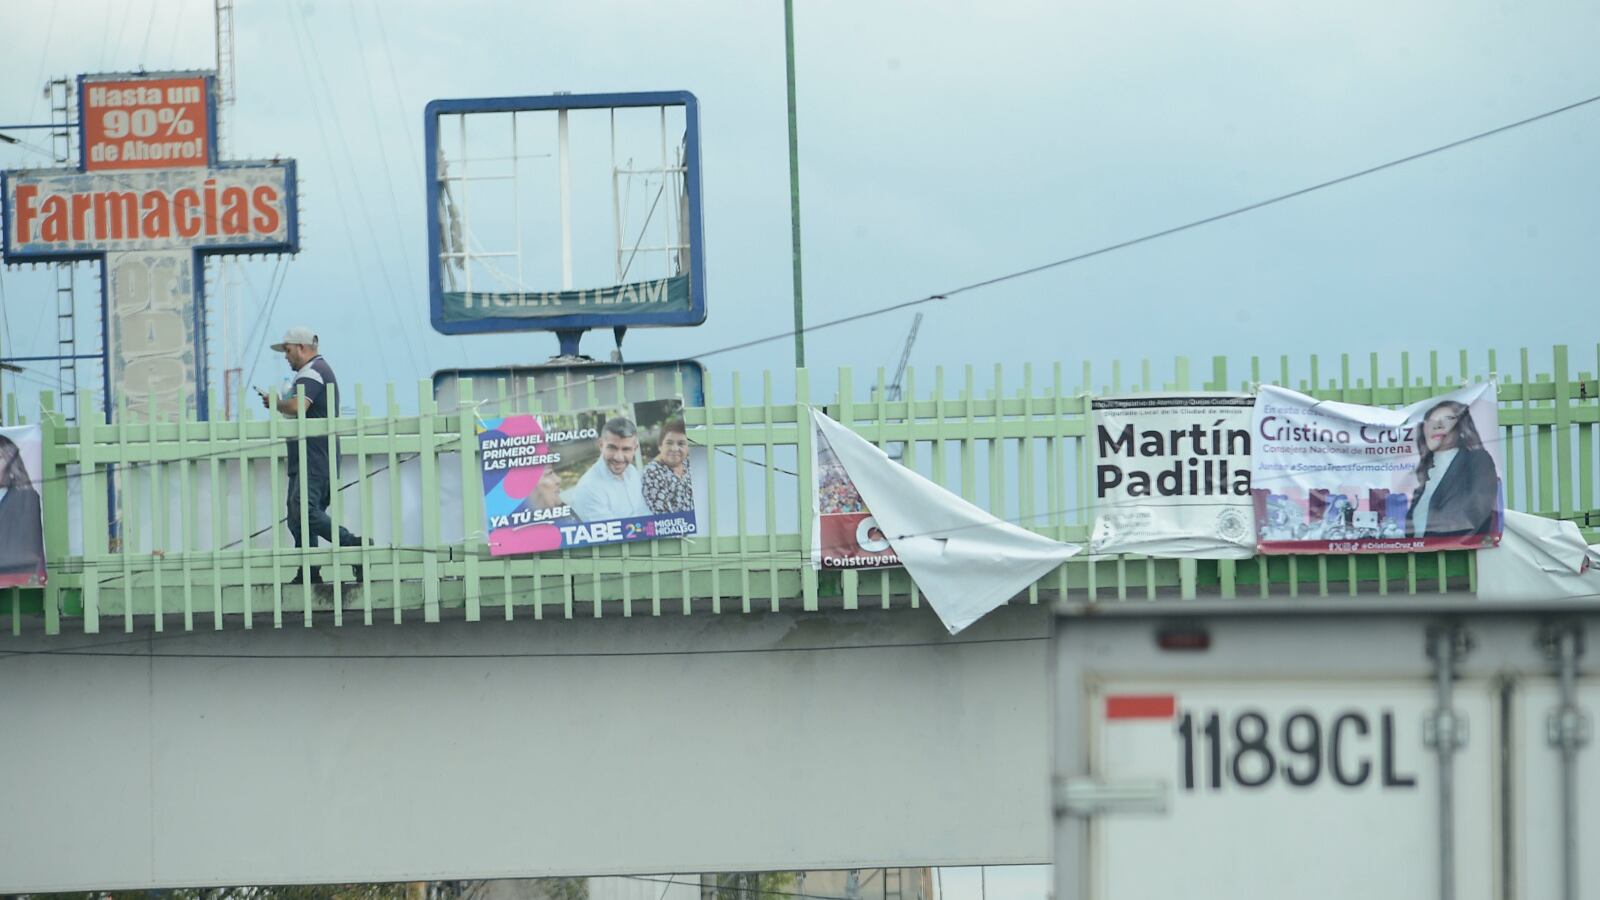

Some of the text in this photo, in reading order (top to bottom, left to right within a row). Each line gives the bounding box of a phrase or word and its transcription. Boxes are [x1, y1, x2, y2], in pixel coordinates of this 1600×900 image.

[89, 86, 200, 108] Hasta un
[103, 107, 195, 138] 90%
[91, 137, 203, 162] de Ahorro!
[15, 179, 281, 244] Farmacias
[1097, 419, 1251, 458] Martín
[1260, 416, 1414, 444] Cristina Cruz
[482, 438, 499, 450] EN
[500, 434, 543, 447] MIGUEL
[483, 445, 536, 460] PRIMERO
[1365, 445, 1412, 455] morena
[484, 453, 561, 471] LAS MUJERES
[1097, 457, 1252, 498] Padilla
[489, 505, 572, 528] YA TÚ SABE
[654, 518, 688, 529] MIGUEL
[560, 521, 624, 545] TABE
[655, 523, 696, 537] HIDALGO
[1178, 709, 1417, 790] 1189CL
